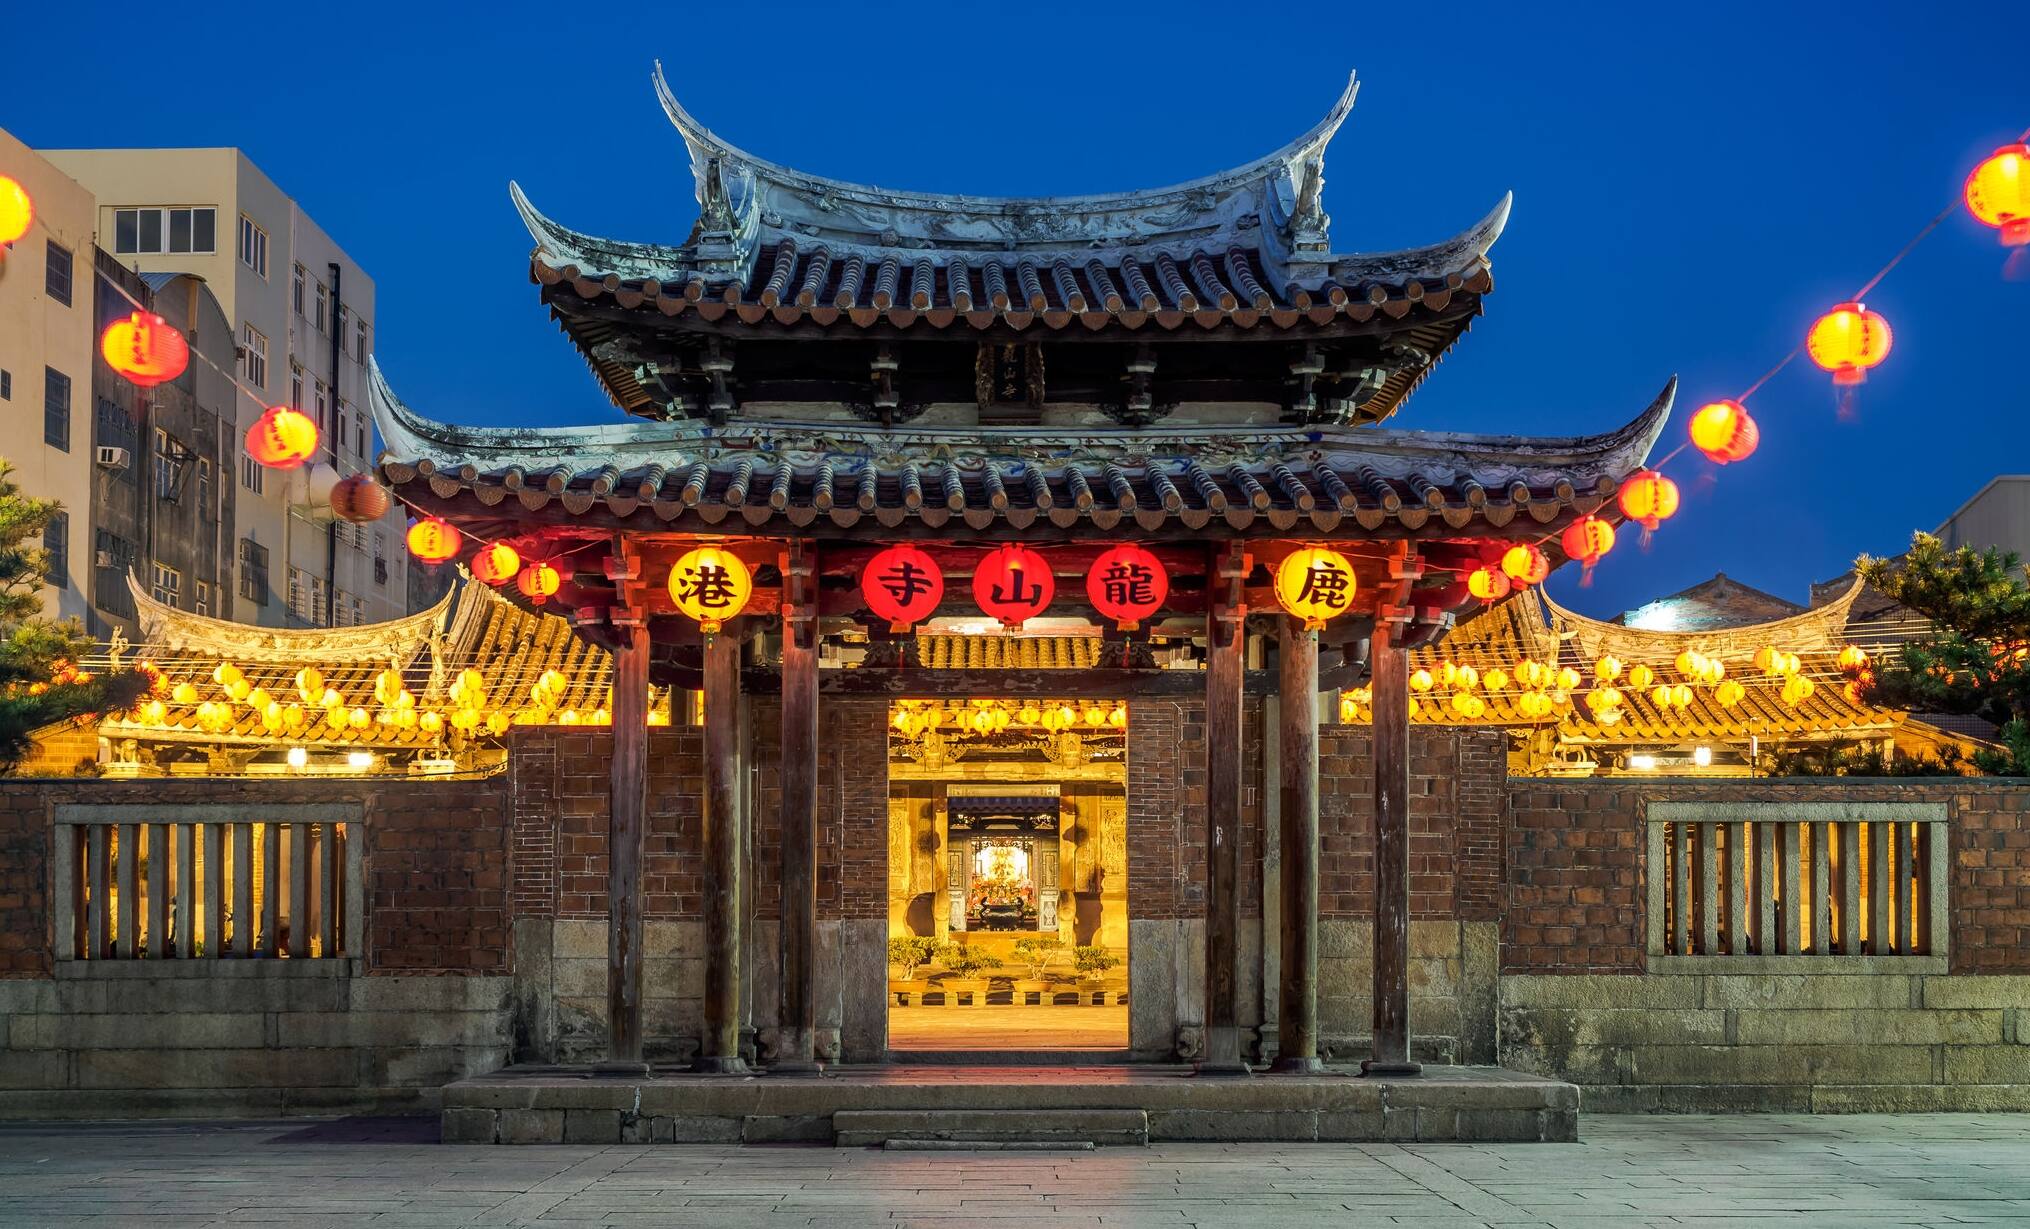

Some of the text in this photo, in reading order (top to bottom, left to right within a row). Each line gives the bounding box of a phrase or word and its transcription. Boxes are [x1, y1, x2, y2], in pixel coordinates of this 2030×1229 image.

[679, 566, 737, 608] 港
[877, 561, 933, 607] 寺
[991, 568, 1042, 607] 山
[1101, 562, 1156, 606] 龍
[1296, 561, 1349, 608] 鹿
